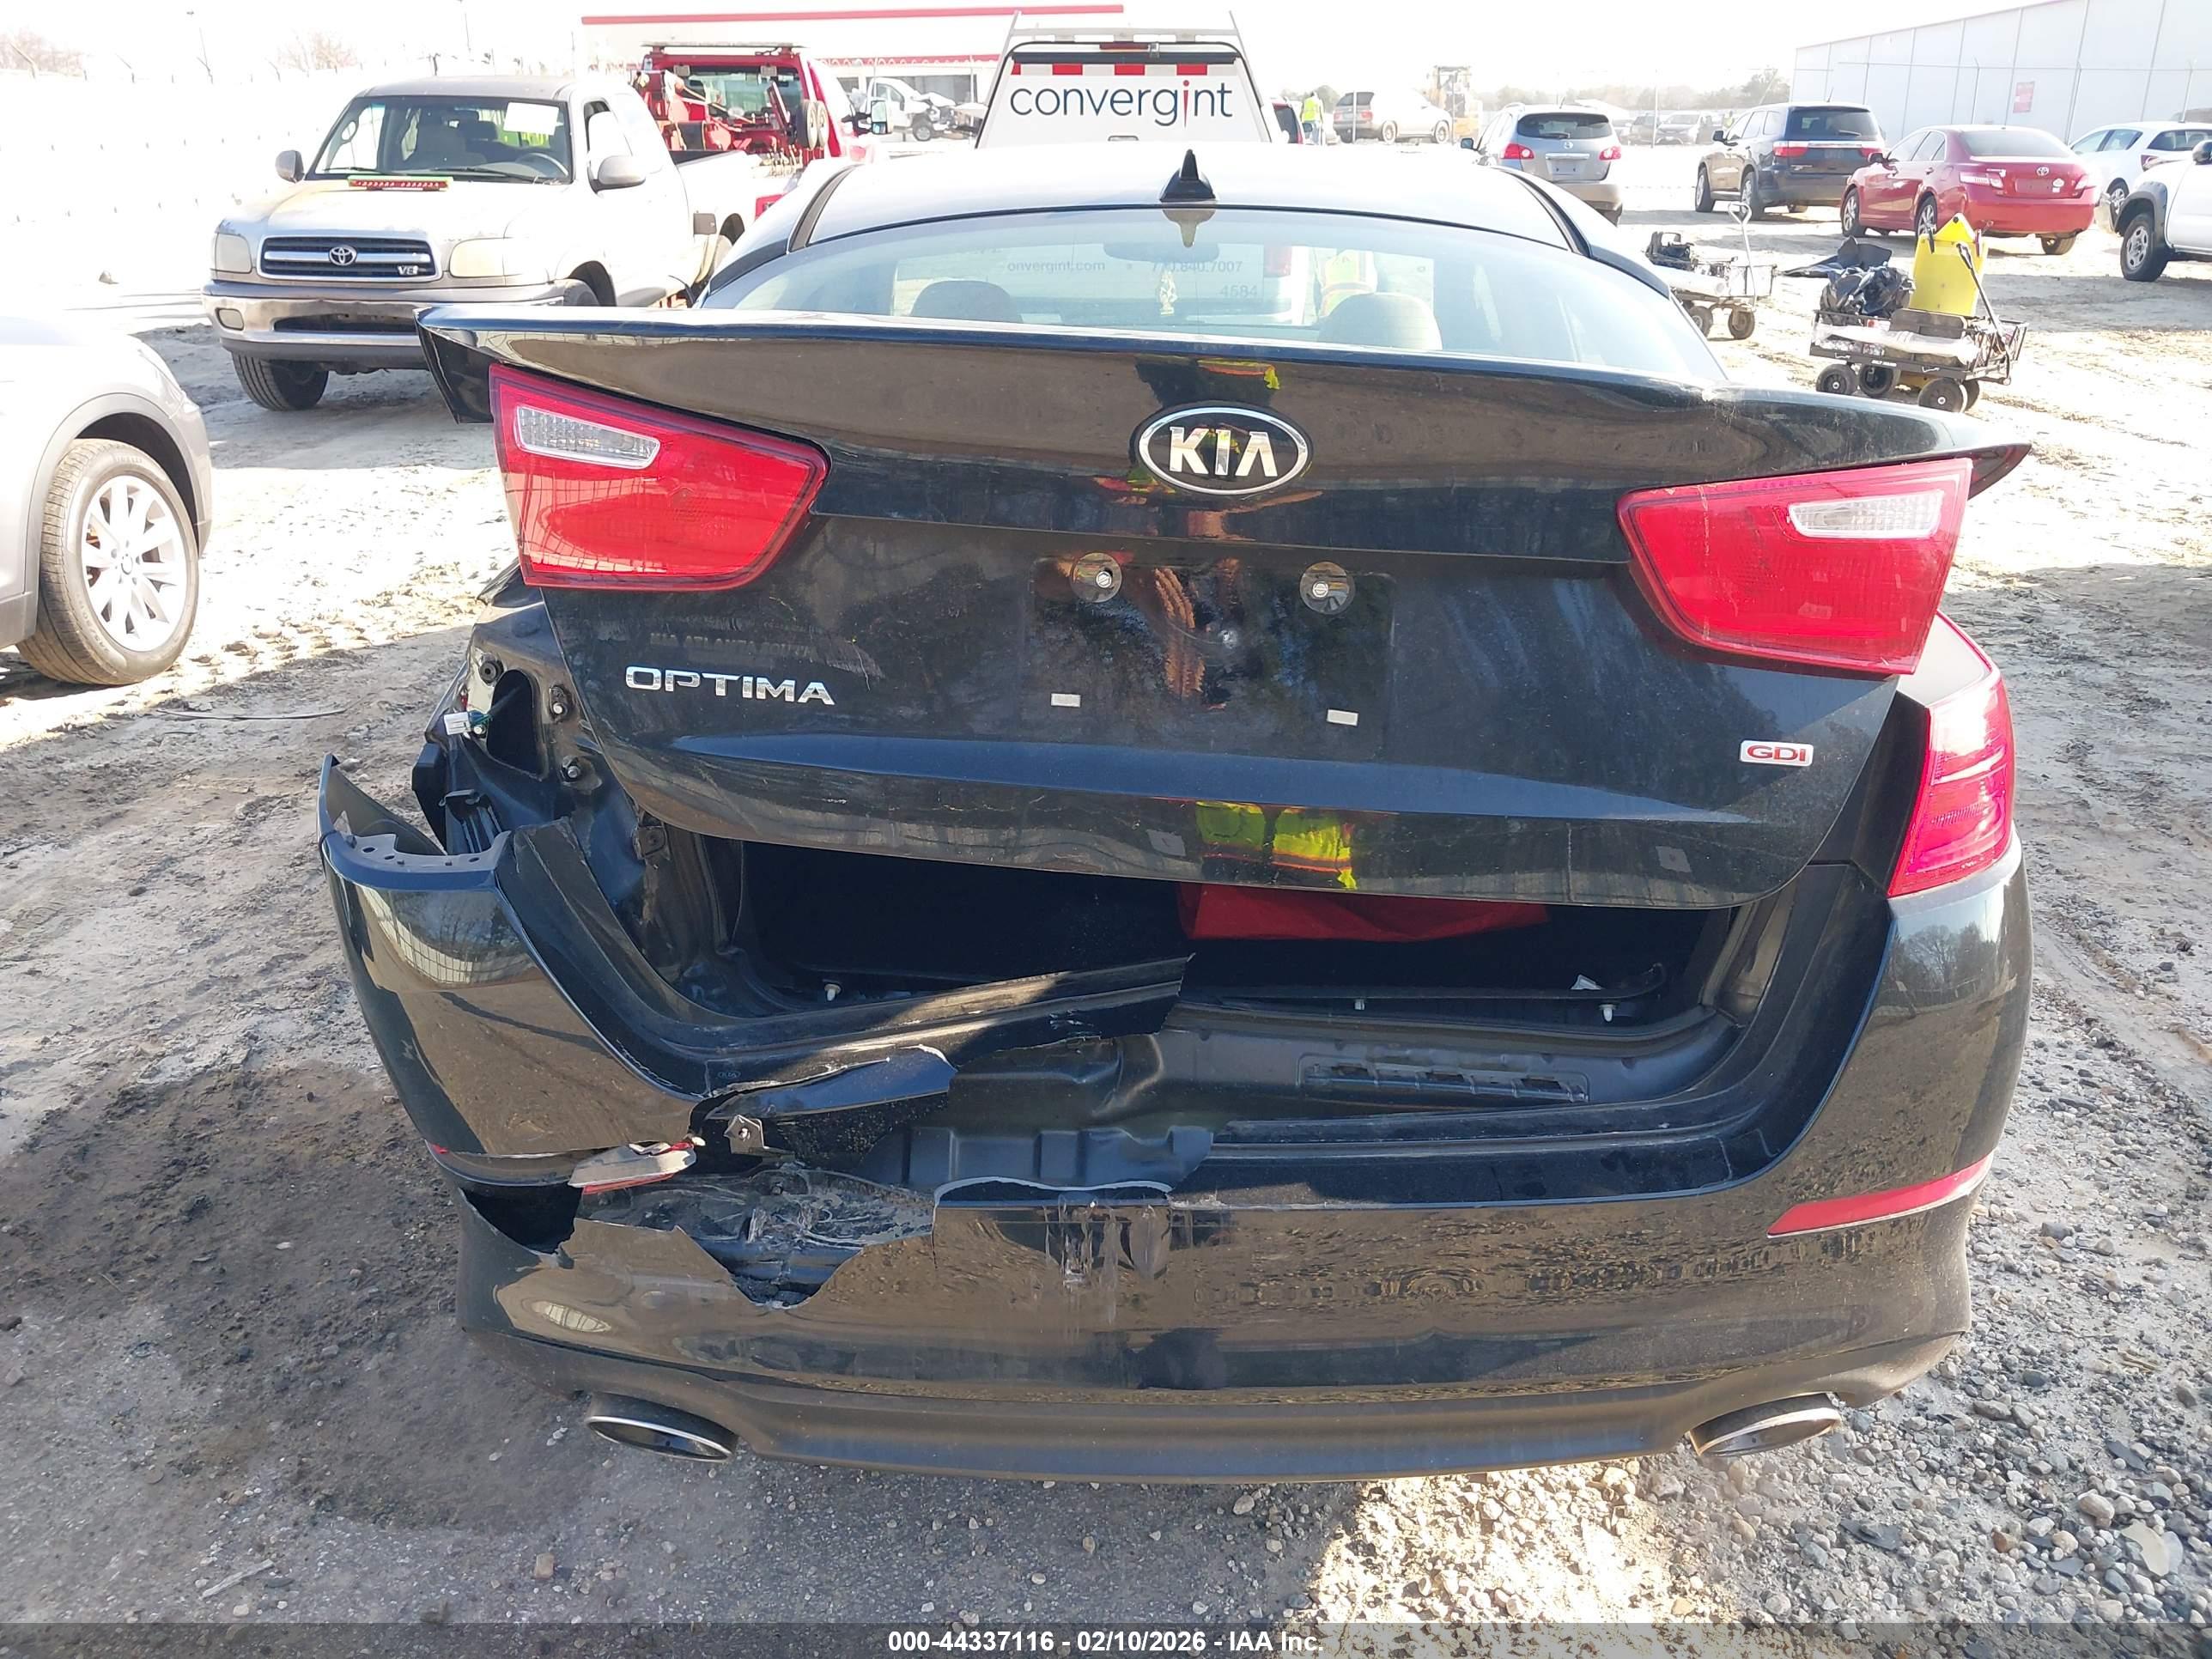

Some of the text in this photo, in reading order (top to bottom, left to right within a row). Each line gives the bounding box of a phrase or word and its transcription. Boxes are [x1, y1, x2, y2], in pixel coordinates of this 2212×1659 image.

[1010, 79, 1233, 129] convergint
[1007, 260, 1105, 274] onvergint.com
[1169, 425, 1279, 477] KIA
[625, 665, 836, 706] OPTIMA
[1746, 744, 1808, 763] GDI
